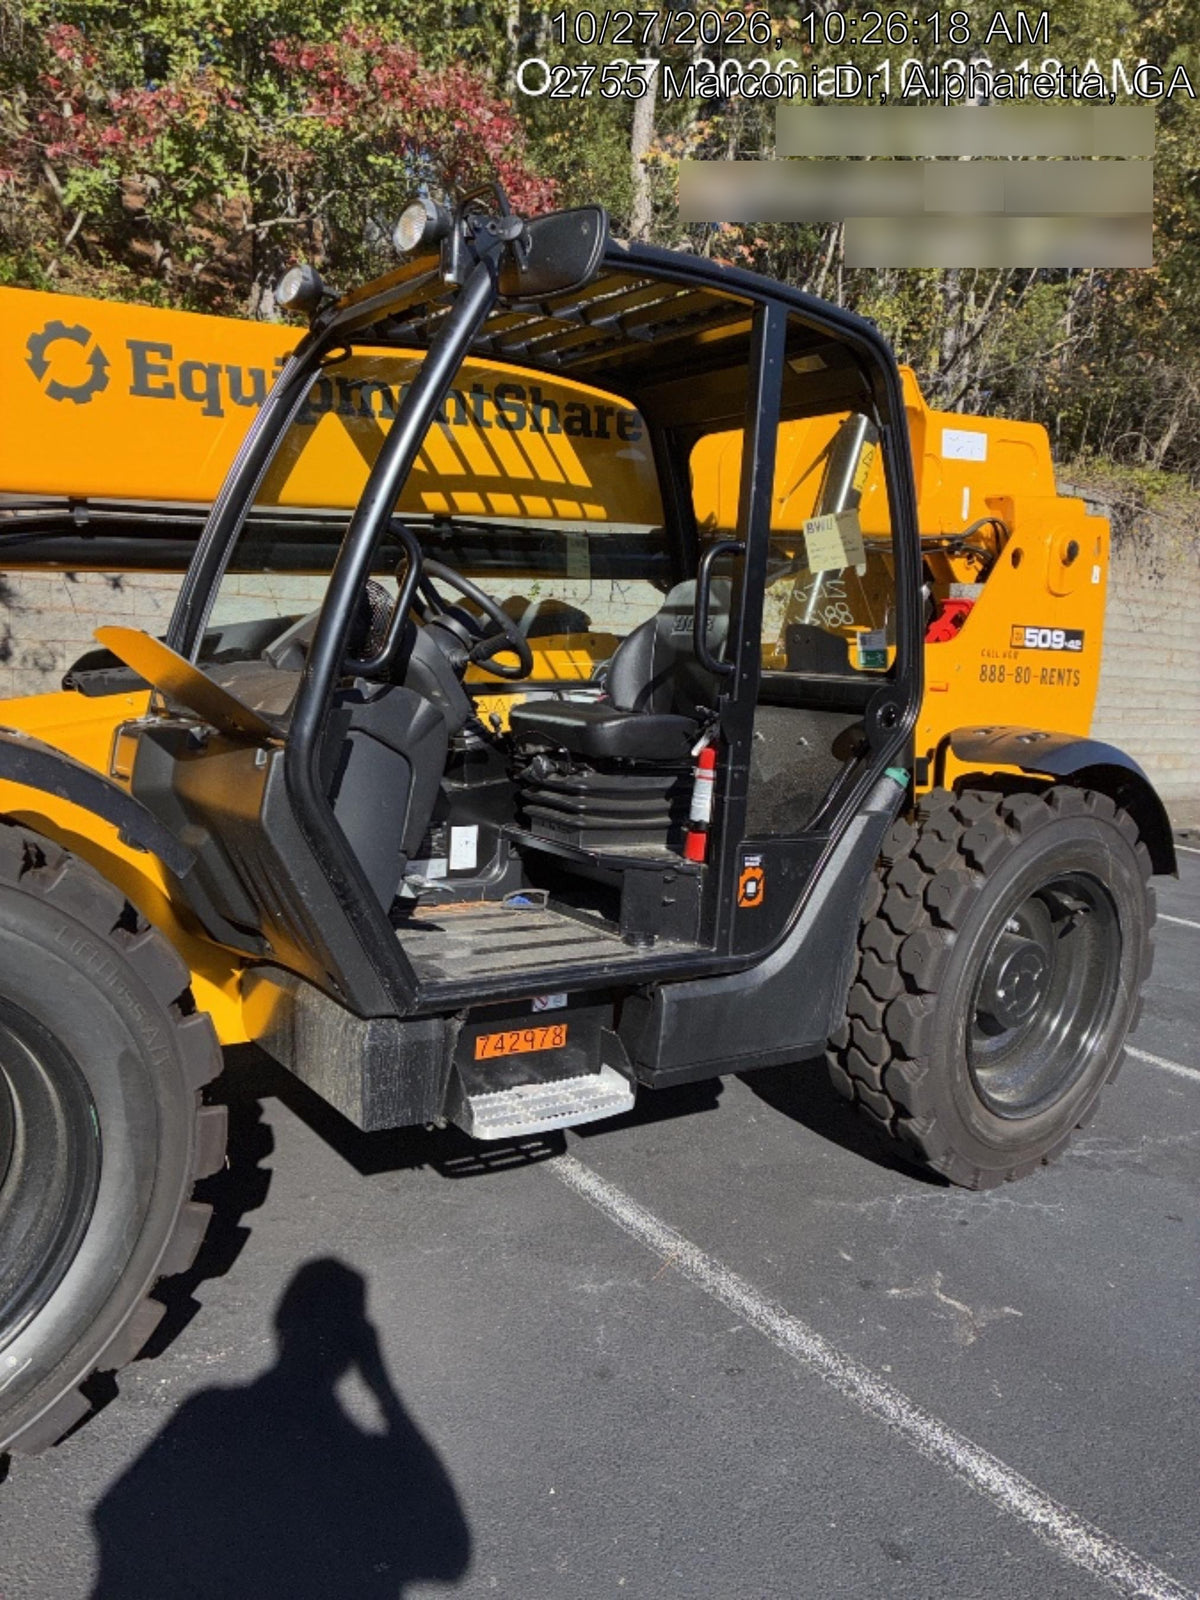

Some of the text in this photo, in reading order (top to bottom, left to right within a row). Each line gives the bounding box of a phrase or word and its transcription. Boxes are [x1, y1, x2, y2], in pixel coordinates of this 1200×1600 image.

[126, 339, 643, 441] EqupmntShare
[979, 664, 1081, 687] 888-80-RENTS
[479, 1026, 563, 1057] 742978
